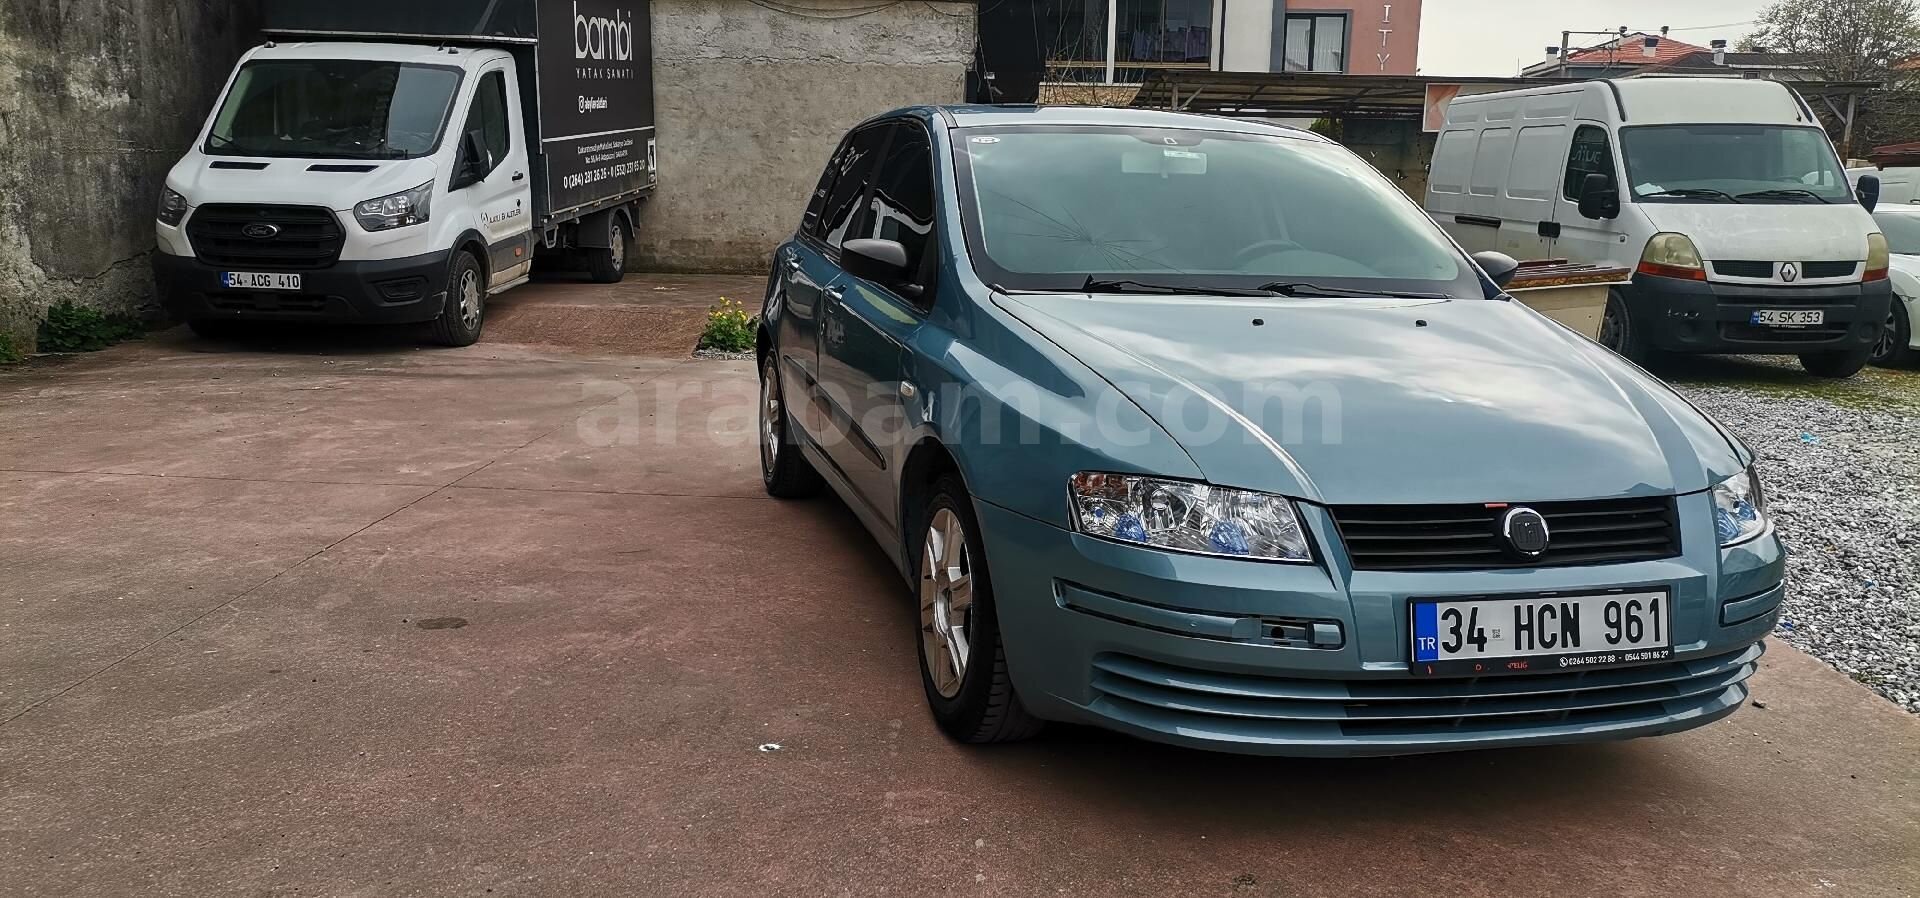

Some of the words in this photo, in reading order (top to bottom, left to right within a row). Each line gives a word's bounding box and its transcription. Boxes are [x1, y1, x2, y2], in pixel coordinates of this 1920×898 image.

[573, 0, 632, 61] bambi
[576, 67, 603, 79] YATAK
[606, 68, 634, 80] SANATI
[563, 175, 568, 189] 0
[228, 273, 243, 286] 54
[251, 273, 271, 287] ACG
[278, 275, 300, 288] 410
[1760, 311, 1774, 322] 54
[1779, 311, 1797, 323] SK
[1799, 311, 1821, 323] 353
[1441, 606, 1487, 654] 34
[1514, 602, 1581, 651] HCN
[1604, 597, 1661, 646] 961
[1418, 636, 1436, 651] TR
[1568, 656, 1585, 666] 0264
[1624, 652, 1640, 661] 0544
[1640, 651, 1652, 660] 501
